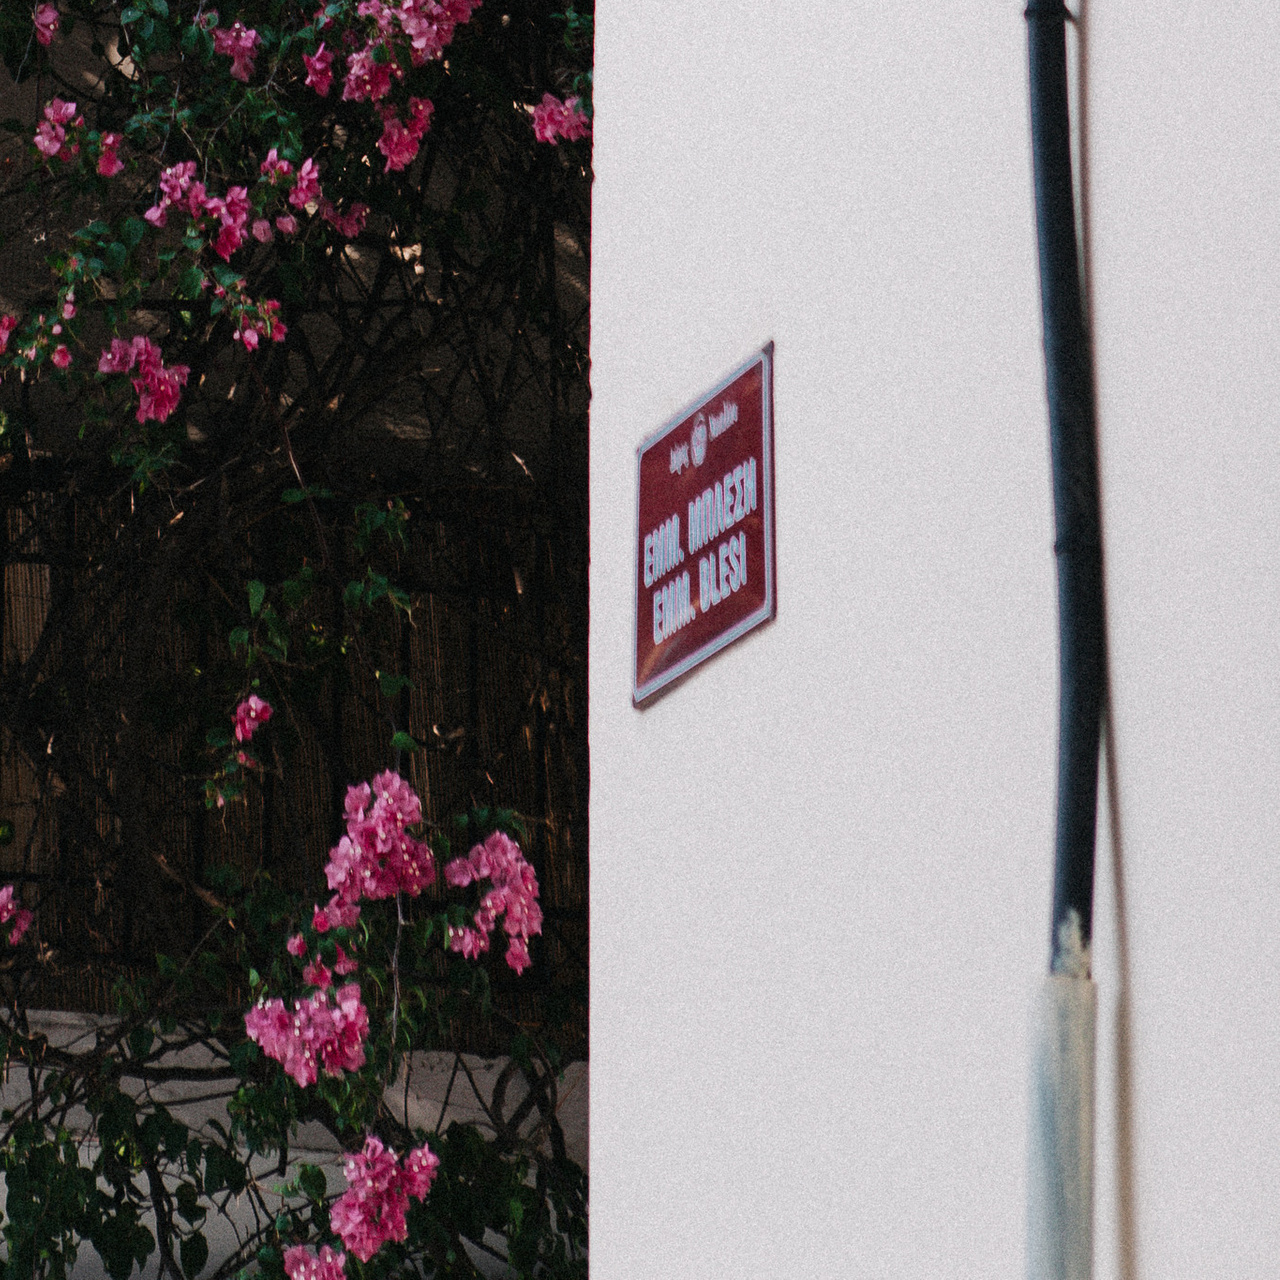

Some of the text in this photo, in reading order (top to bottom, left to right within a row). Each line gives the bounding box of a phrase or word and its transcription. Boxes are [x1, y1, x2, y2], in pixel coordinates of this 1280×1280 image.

[644, 457, 757, 588] ΕΜΜ. ΜΠΛΕΣΗ
[653, 531, 747, 645] EMM. BLESI
